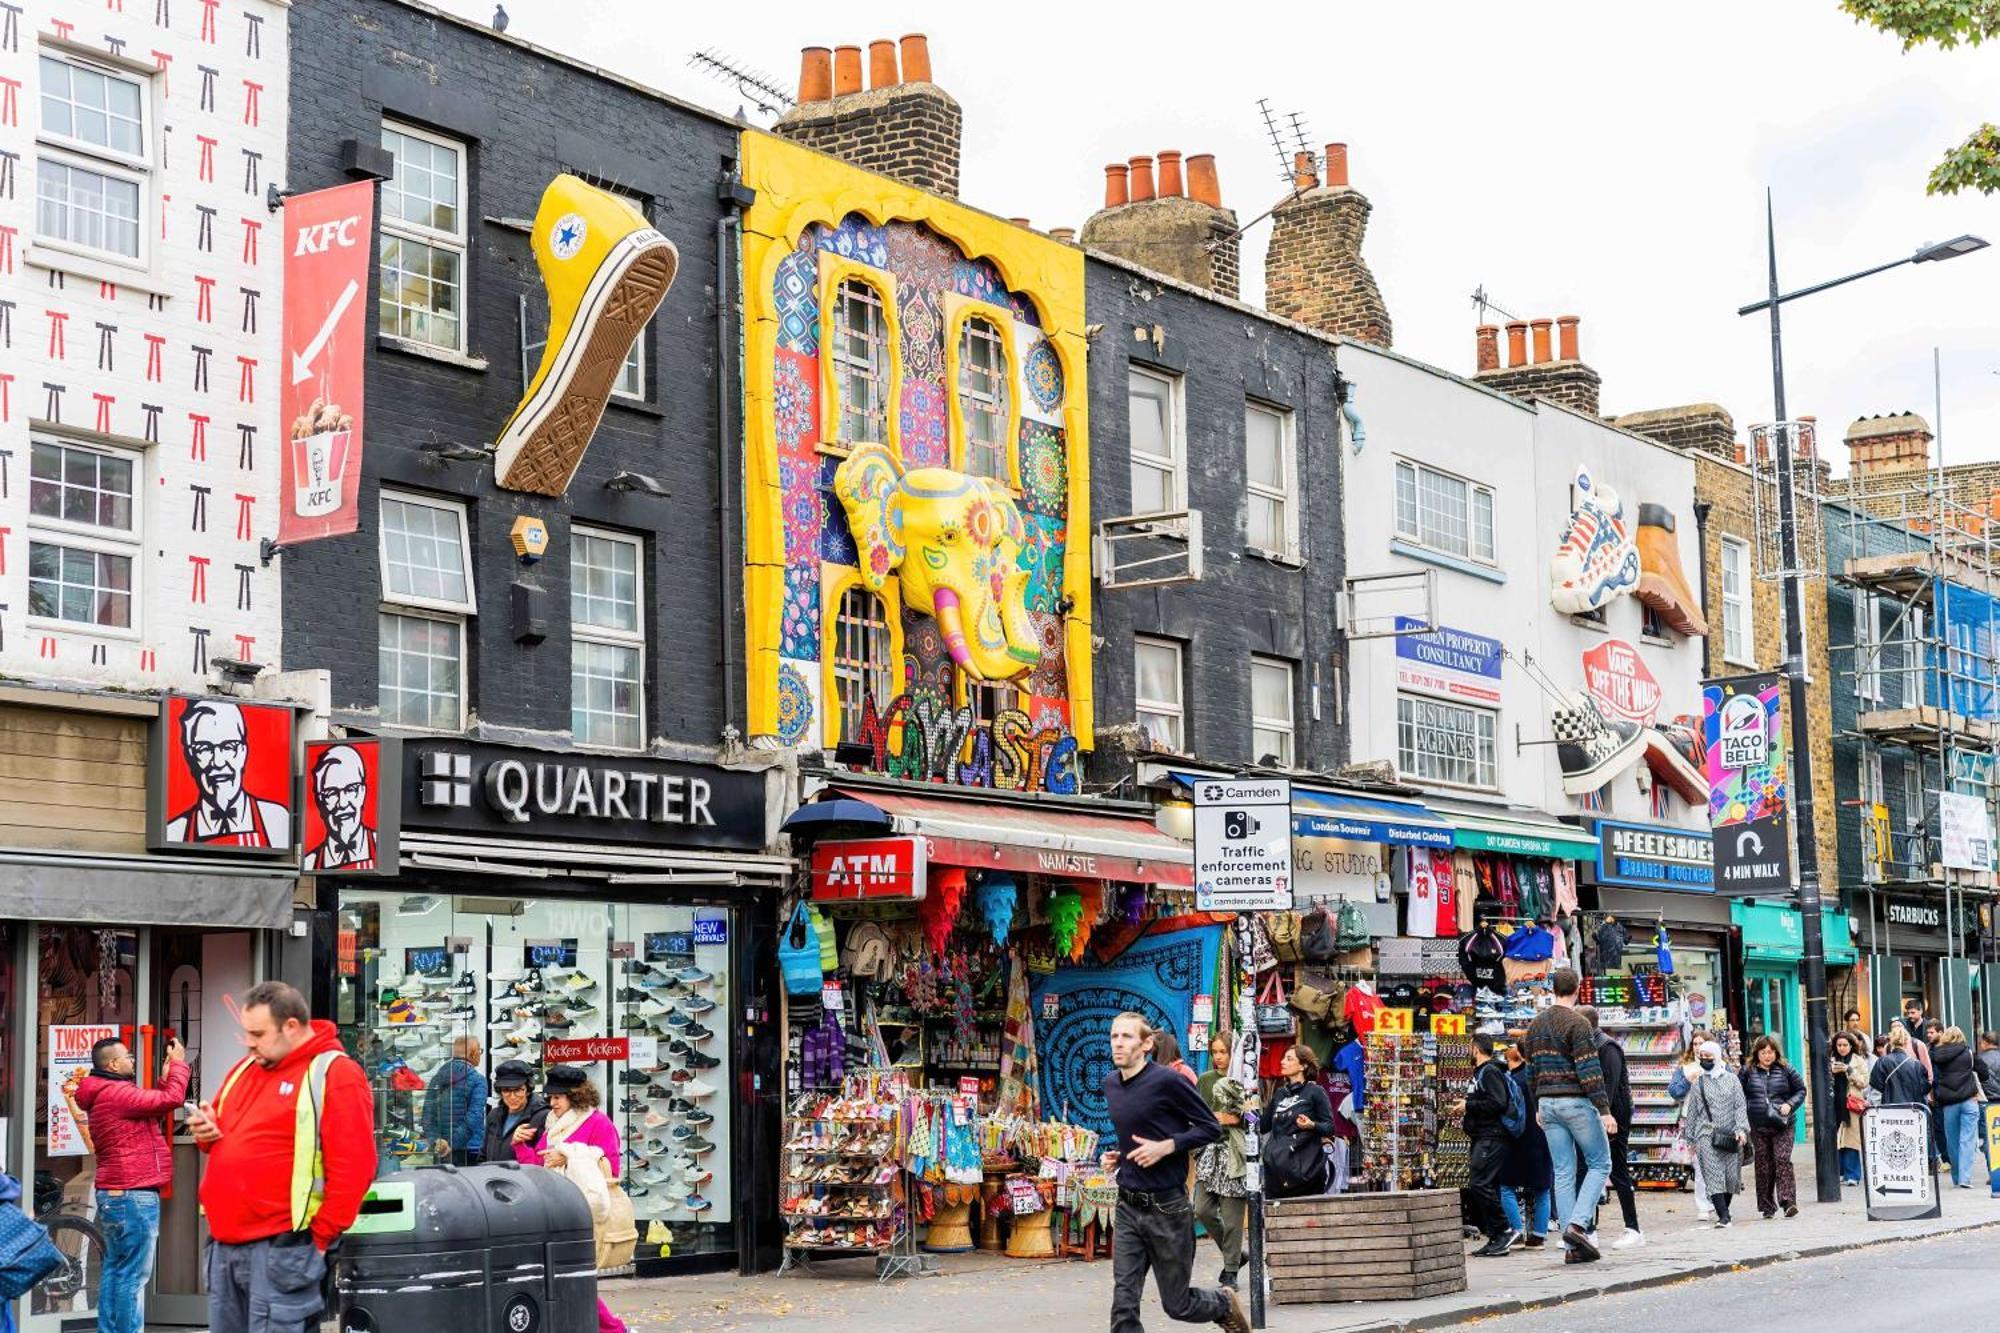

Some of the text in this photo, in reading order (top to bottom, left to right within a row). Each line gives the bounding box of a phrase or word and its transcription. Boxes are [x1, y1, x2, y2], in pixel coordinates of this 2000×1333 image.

[293, 217, 357, 257] KFC
[307, 488, 332, 506] KFC
[1446, 633, 1492, 657] PROPERTY
[1417, 644, 1483, 673] CONSULTANCY
[1606, 643, 1636, 677] VANS
[1416, 702, 1475, 733] ESTATE
[1416, 727, 1475, 758] AGENTS
[1722, 734, 1762, 750] TACO
[1725, 749, 1762, 763] BELL
[494, 759, 717, 826] QUARTER
[1226, 787, 1281, 798] Camden
[1311, 820, 1340, 833] London
[1341, 825, 1371, 837] Souvenir
[1422, 831, 1450, 845] Clothing
[1221, 846, 1265, 858] Traffic
[826, 854, 897, 886] ATM
[1038, 852, 1097, 875] NAMASTE
[1201, 860, 1286, 872] enforcement
[1324, 851, 1377, 877] STUDIO
[1724, 863, 1780, 880] 4 MIN WALK
[1216, 876, 1272, 885] cameras
[1214, 898, 1275, 906] camden.gov.uk
[1889, 905, 1939, 926] STARBUCKS
[694, 922, 718, 934] NEW
[1379, 1011, 1406, 1030] £1
[1435, 1017, 1458, 1037] £1
